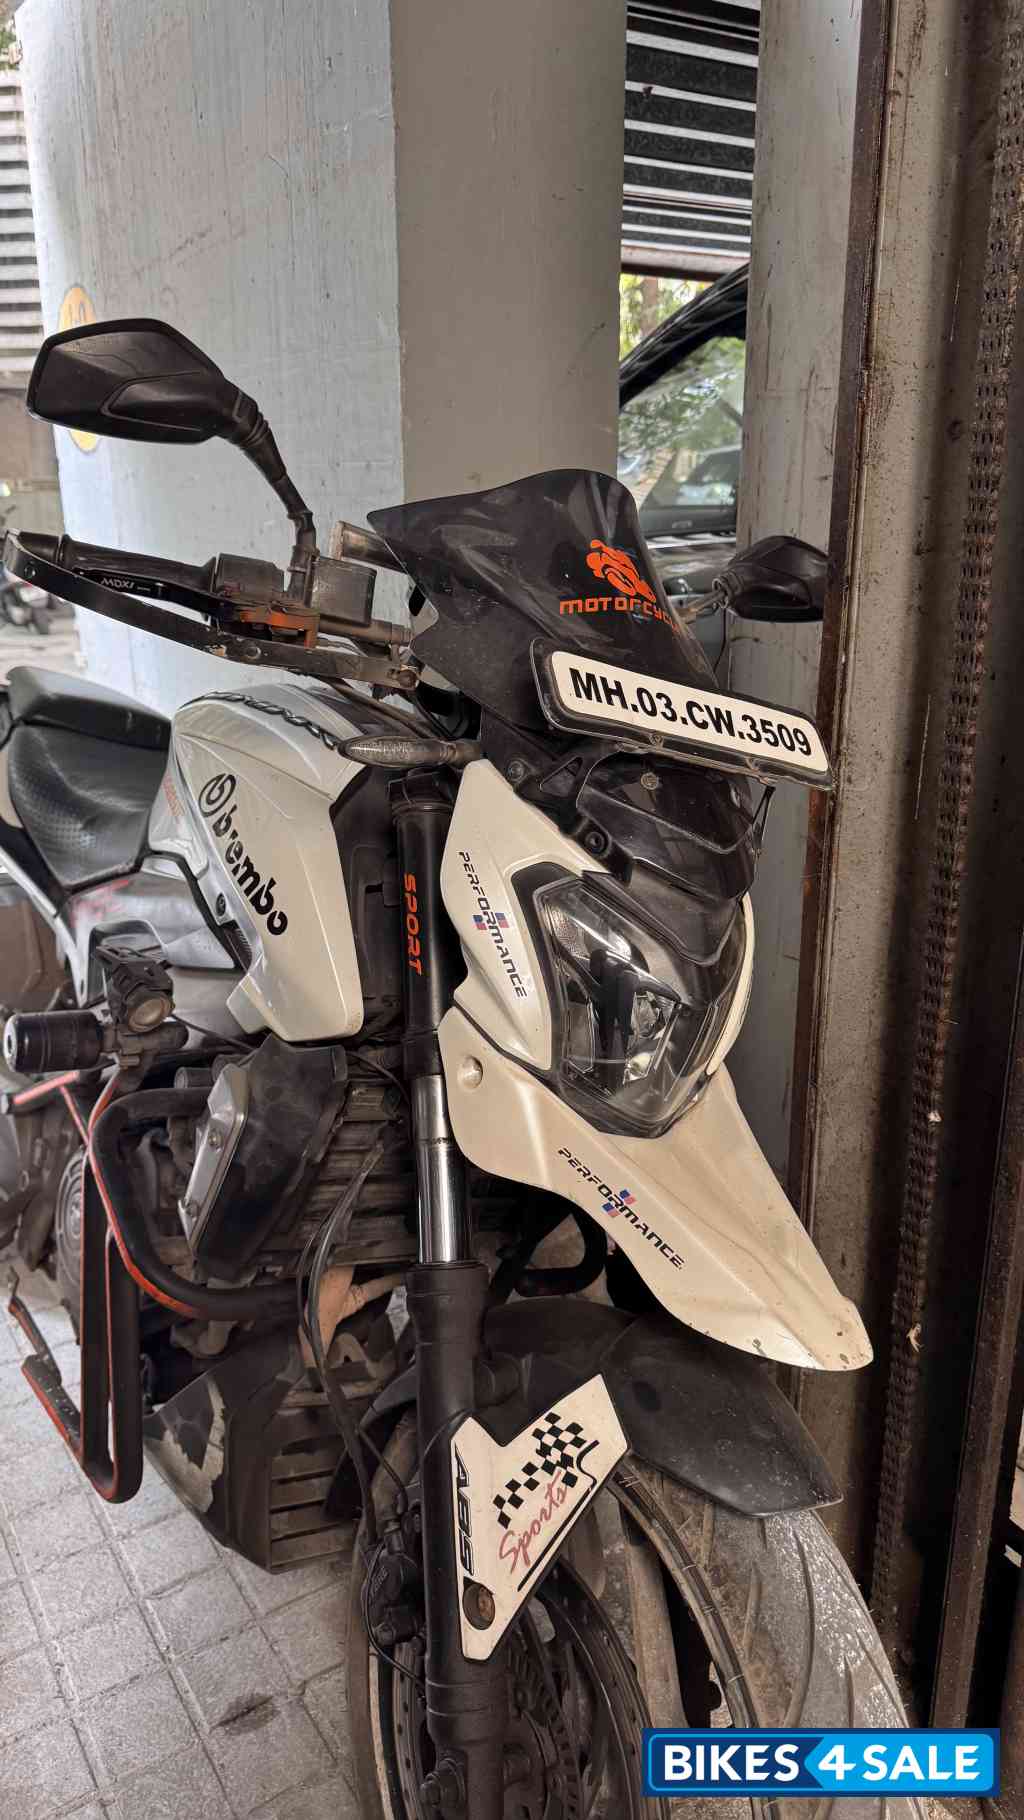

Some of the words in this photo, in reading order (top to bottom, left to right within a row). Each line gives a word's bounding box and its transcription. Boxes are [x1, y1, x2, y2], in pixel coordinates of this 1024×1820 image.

[568, 667, 812, 756] MH.03.CW.3509
[212, 804, 288, 936] brembo
[403, 872, 423, 976] SPORT
[458, 851, 528, 998] PERFORMANCE
[558, 1147, 685, 1270] PERFORMANCE
[454, 1440, 474, 1577] ABS
[499, 1468, 568, 1575] Sports
